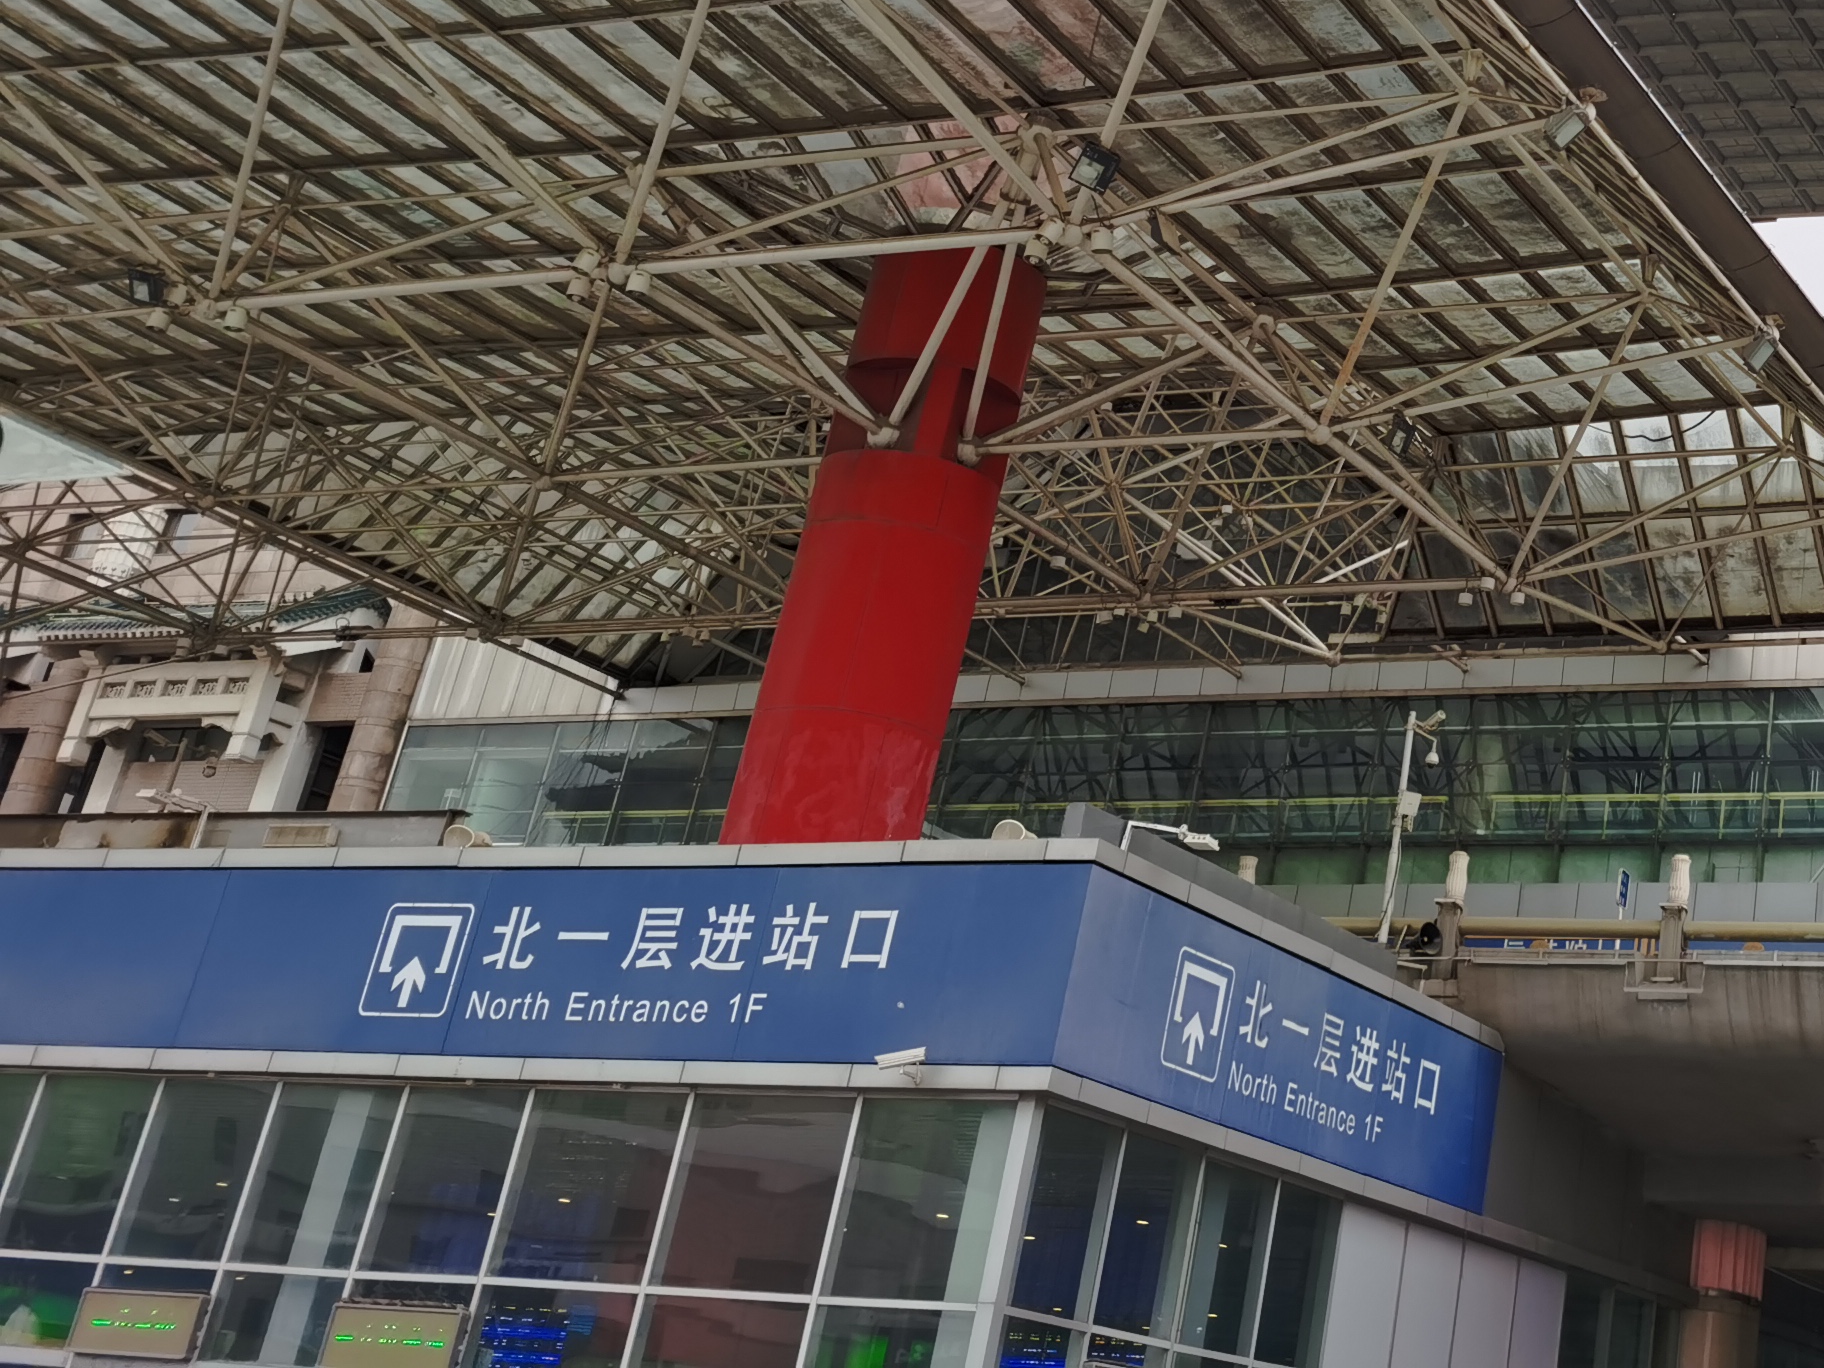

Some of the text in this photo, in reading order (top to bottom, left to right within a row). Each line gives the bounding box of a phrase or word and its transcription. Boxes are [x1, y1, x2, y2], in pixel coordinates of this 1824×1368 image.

[482, 903, 899, 970] 北一层进站口
[465, 991, 768, 1023] North Entrance 1F
[1239, 980, 1441, 1115] 北一层进站口
[1228, 1060, 1384, 1143] North Entrance 1F
